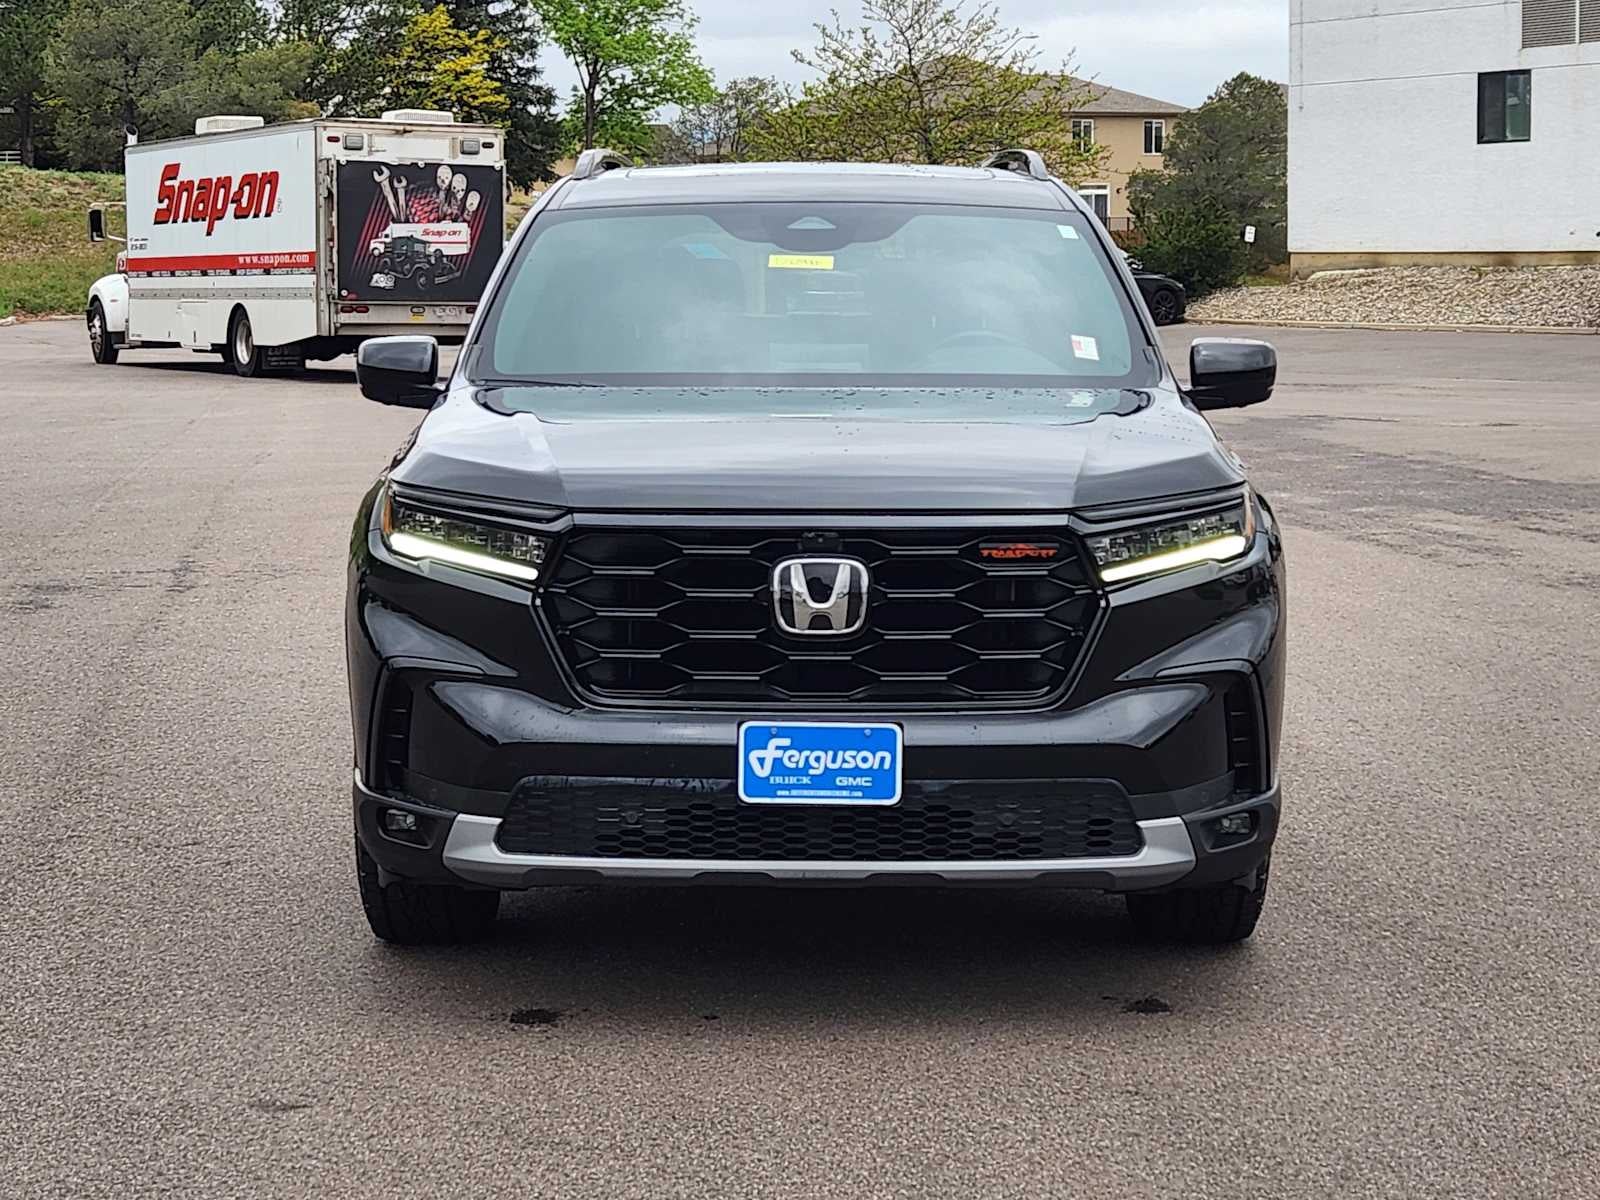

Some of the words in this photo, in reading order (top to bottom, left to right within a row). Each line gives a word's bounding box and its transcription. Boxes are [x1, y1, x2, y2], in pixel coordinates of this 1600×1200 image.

[153, 162, 279, 236] Snap-on
[238, 254, 310, 266] www.snapon.com
[748, 737, 892, 778] Ferguson
[835, 776, 873, 786] GMC
